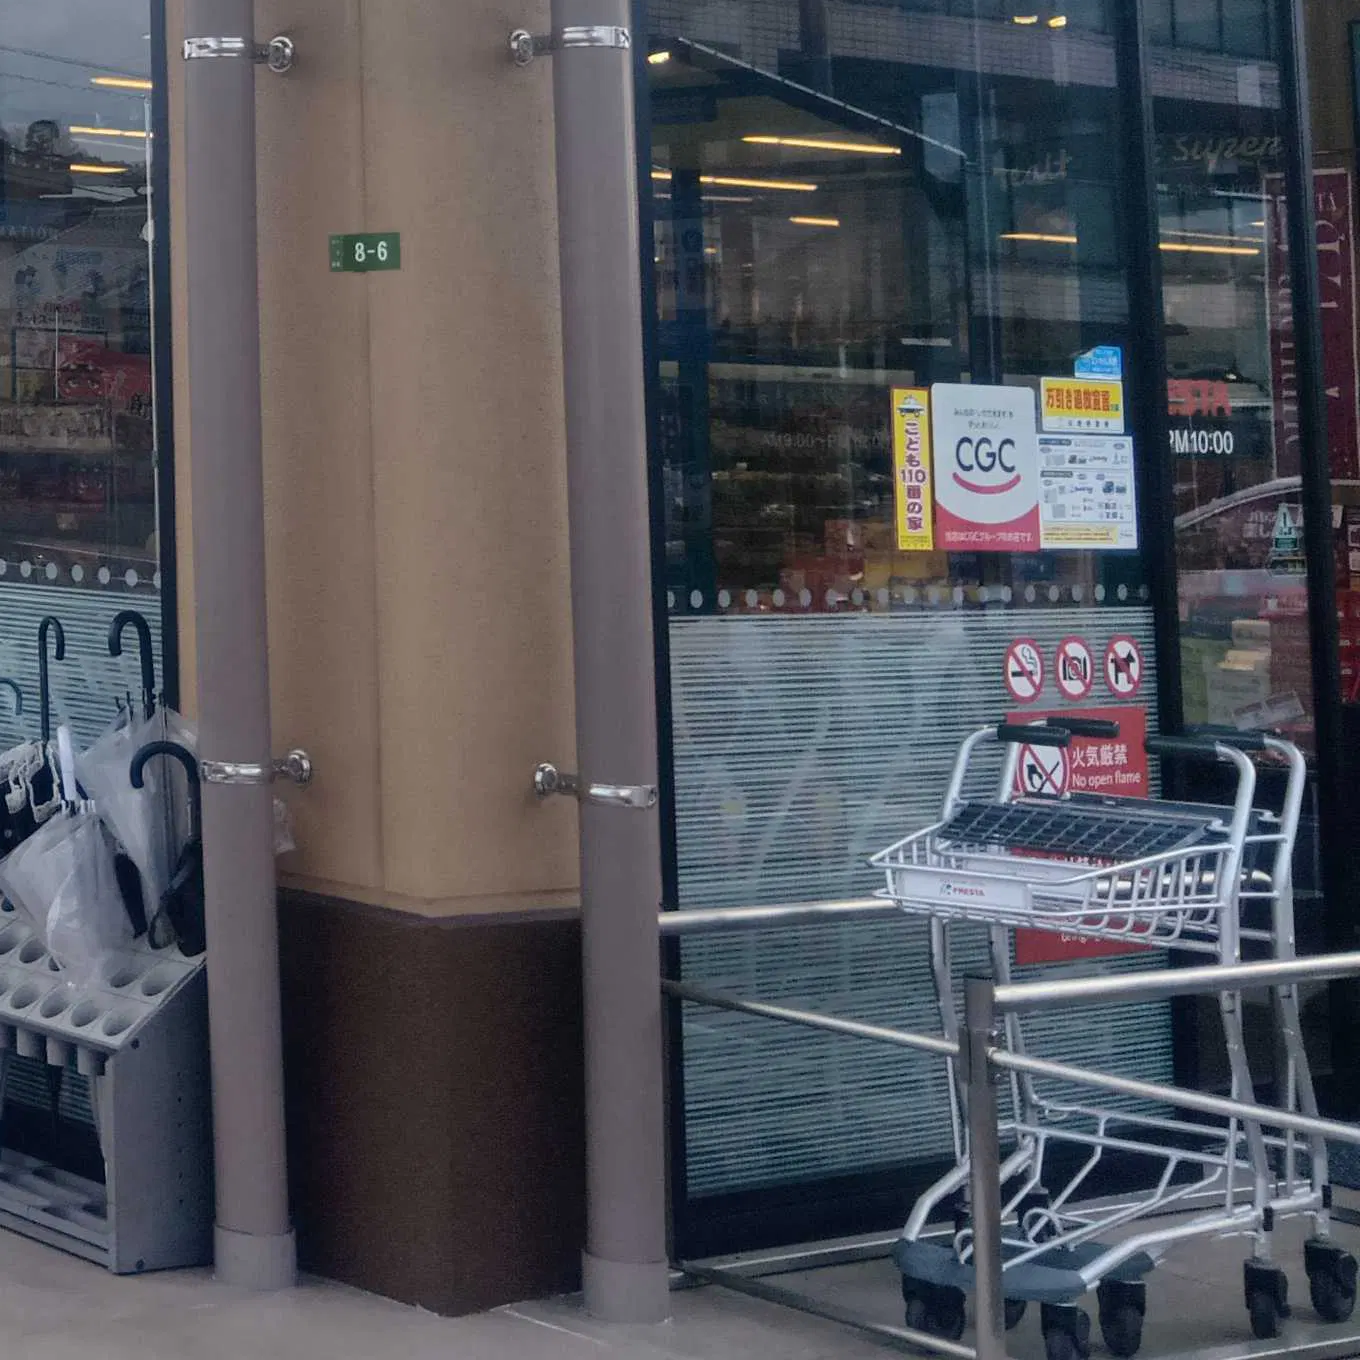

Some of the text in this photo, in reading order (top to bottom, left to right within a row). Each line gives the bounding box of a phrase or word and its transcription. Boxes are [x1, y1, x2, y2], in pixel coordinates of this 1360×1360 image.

[354, 240, 388, 262] 8-6
[955, 436, 1016, 473] CGC
[1072, 743, 1128, 769] 火気厳禁
[1072, 769, 1141, 790] No open flame
